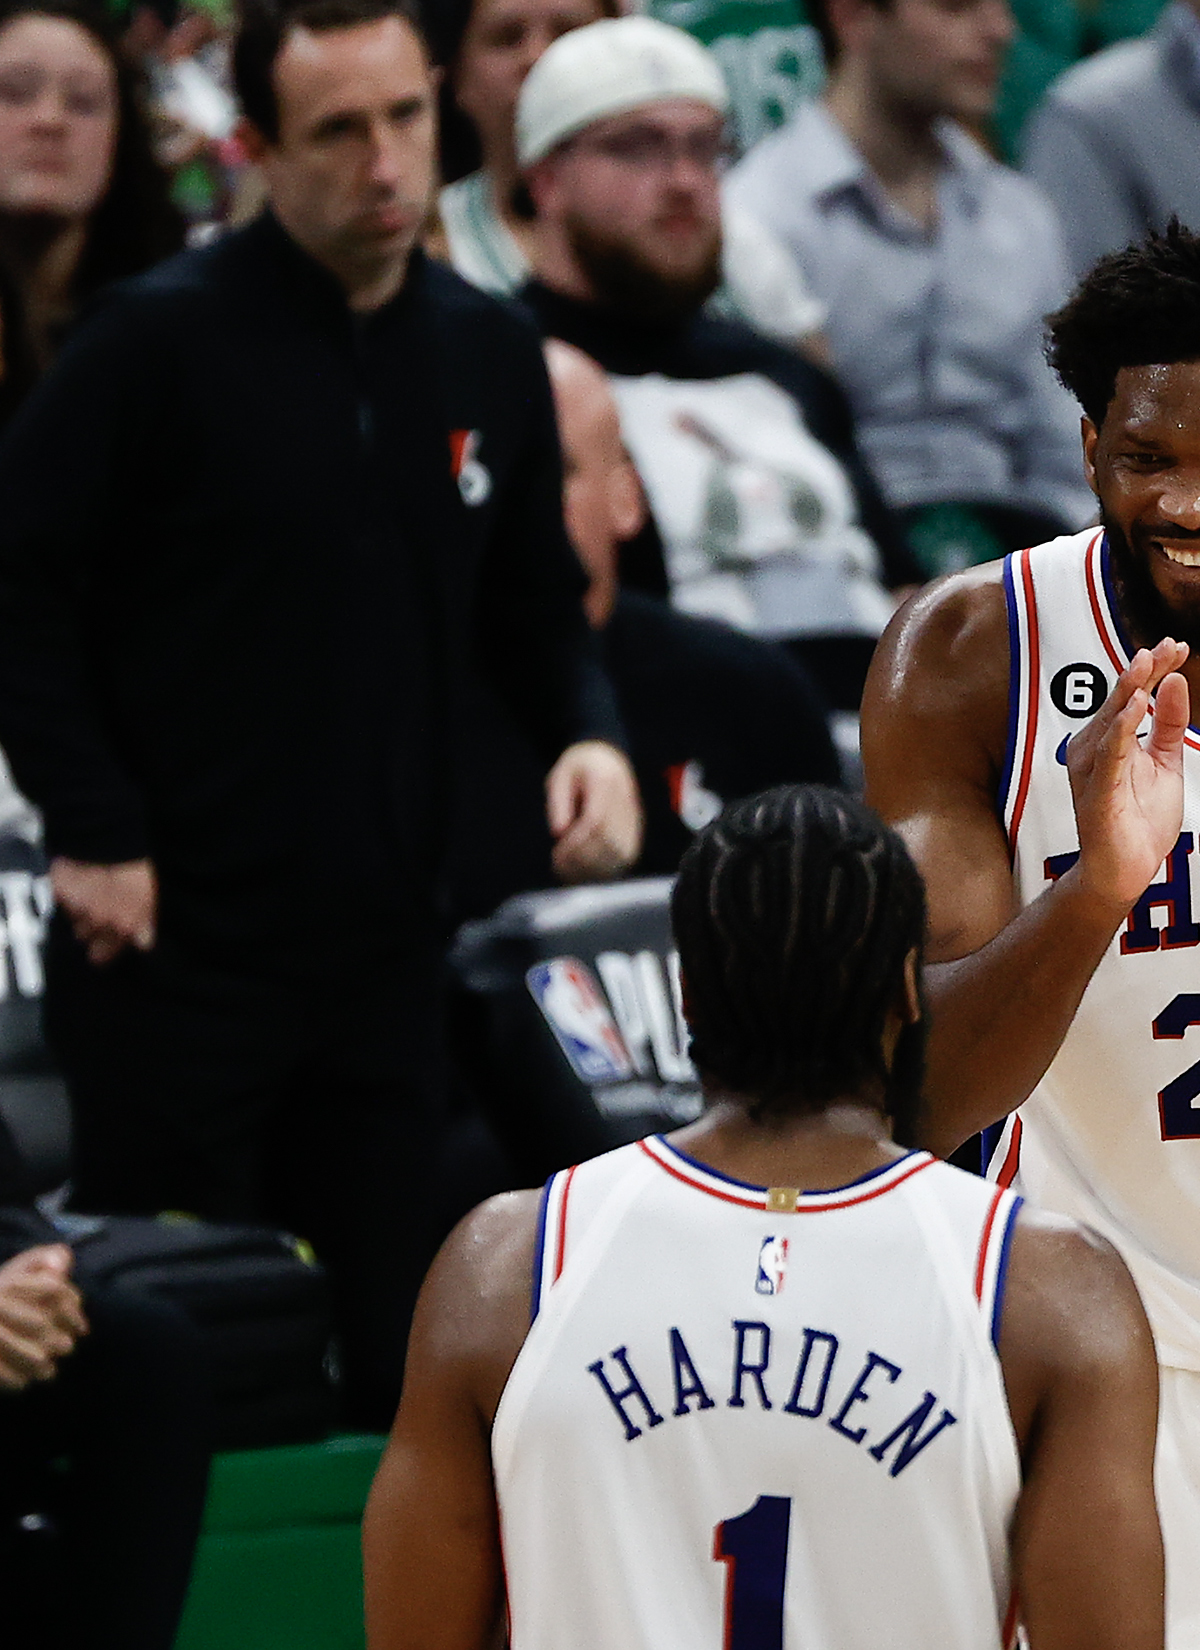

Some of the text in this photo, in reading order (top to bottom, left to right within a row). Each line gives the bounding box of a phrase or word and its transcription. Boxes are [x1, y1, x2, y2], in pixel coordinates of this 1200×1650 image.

[1064, 671, 1094, 711] 6
[586, 1318, 958, 1479] HARDEN
[711, 1494, 792, 1650] 1
